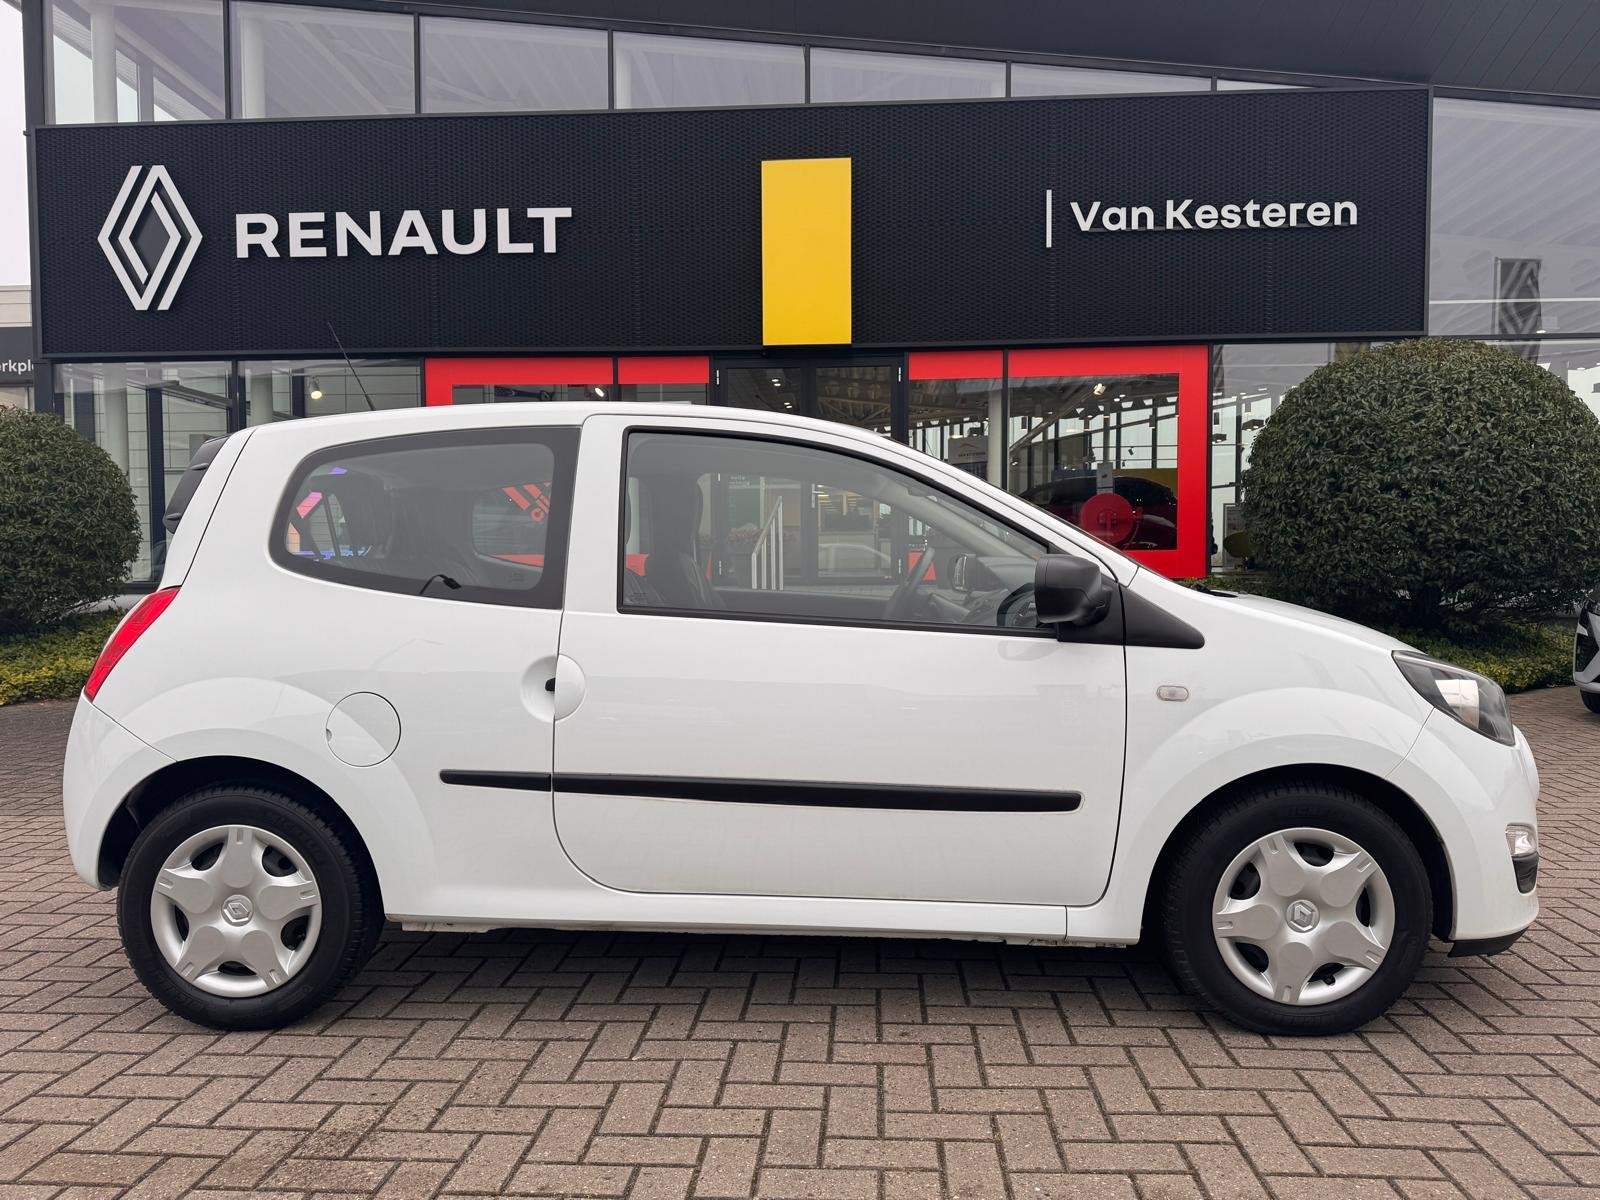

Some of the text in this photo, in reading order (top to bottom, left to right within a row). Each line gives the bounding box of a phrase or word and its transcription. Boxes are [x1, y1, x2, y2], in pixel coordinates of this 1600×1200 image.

[1070, 199, 1358, 232] Van Kesteren
[235, 206, 572, 259] RENAULT
[0, 359, 34, 375] rkpl
